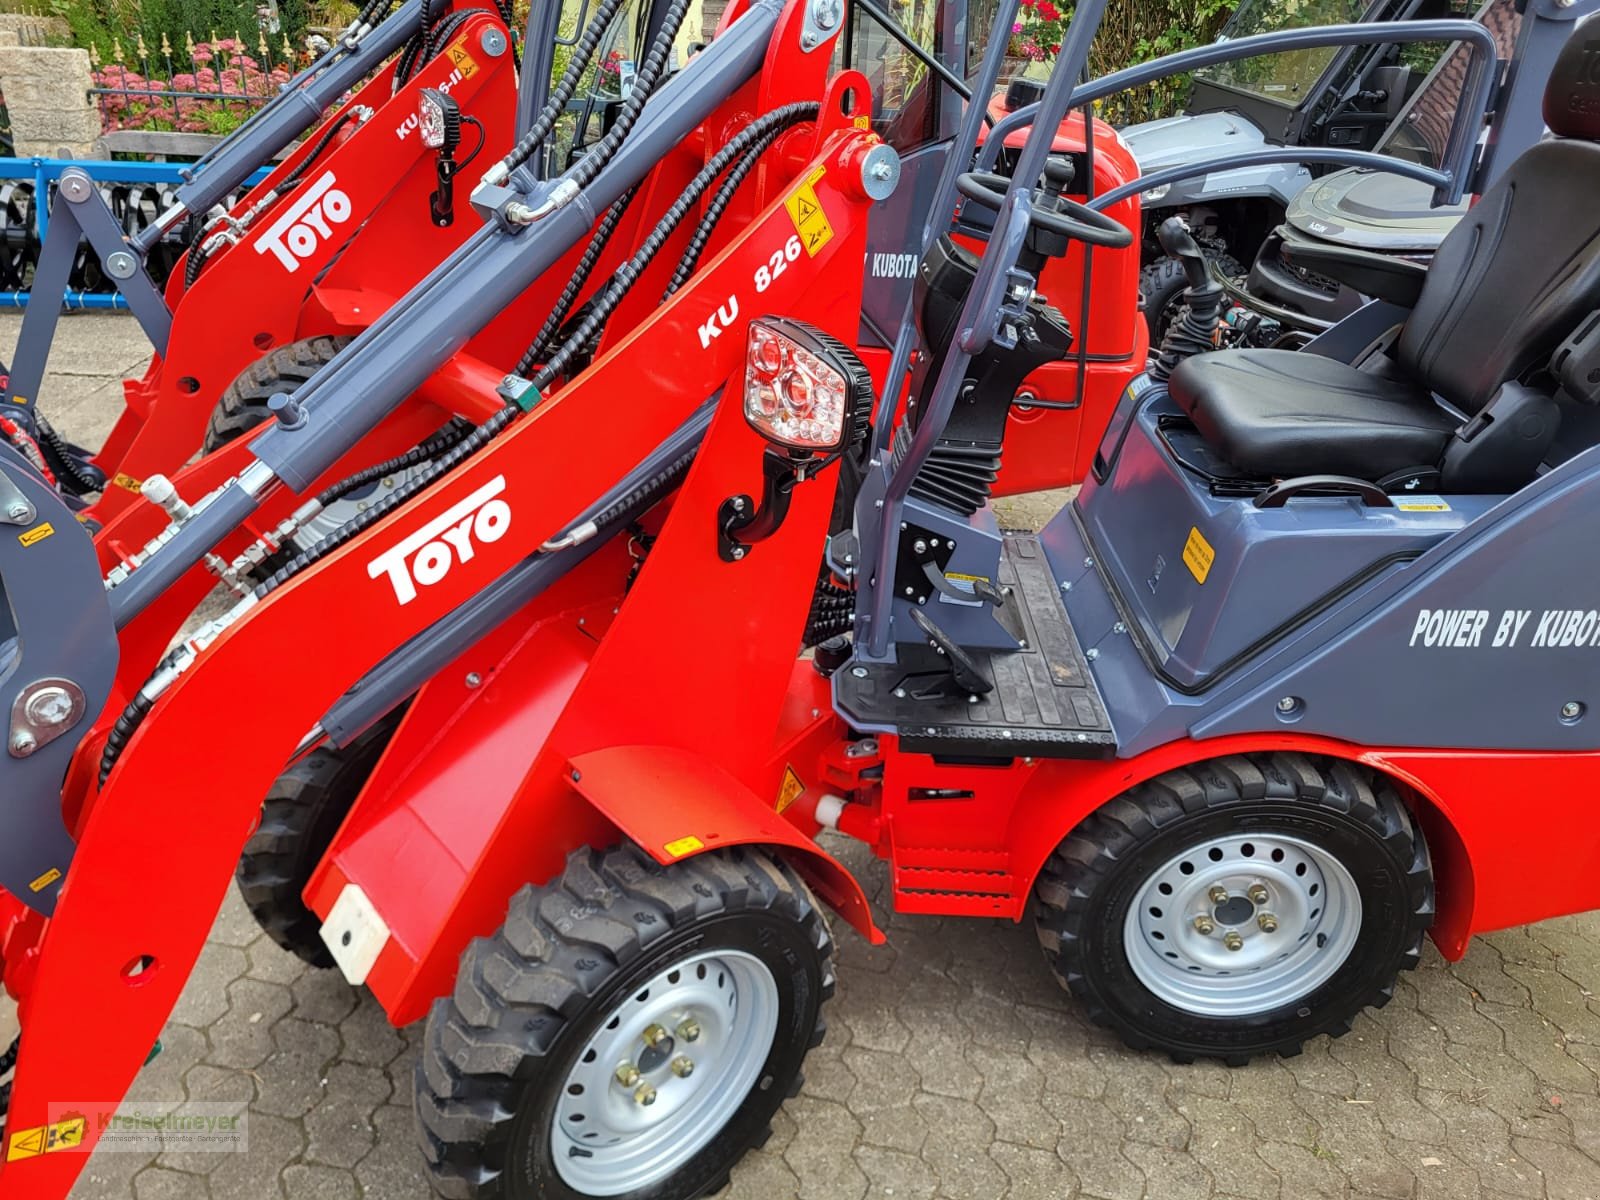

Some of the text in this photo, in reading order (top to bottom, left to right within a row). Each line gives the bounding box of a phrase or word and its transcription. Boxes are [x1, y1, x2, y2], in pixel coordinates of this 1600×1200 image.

[395, 112, 419, 141] KU
[253, 170, 352, 273] TOYO
[697, 234, 802, 349] KU 826
[871, 252, 918, 278] KUBOTA
[366, 473, 512, 606] TOYO
[1408, 608, 1490, 648] POWER
[1491, 609, 1532, 648] BY
